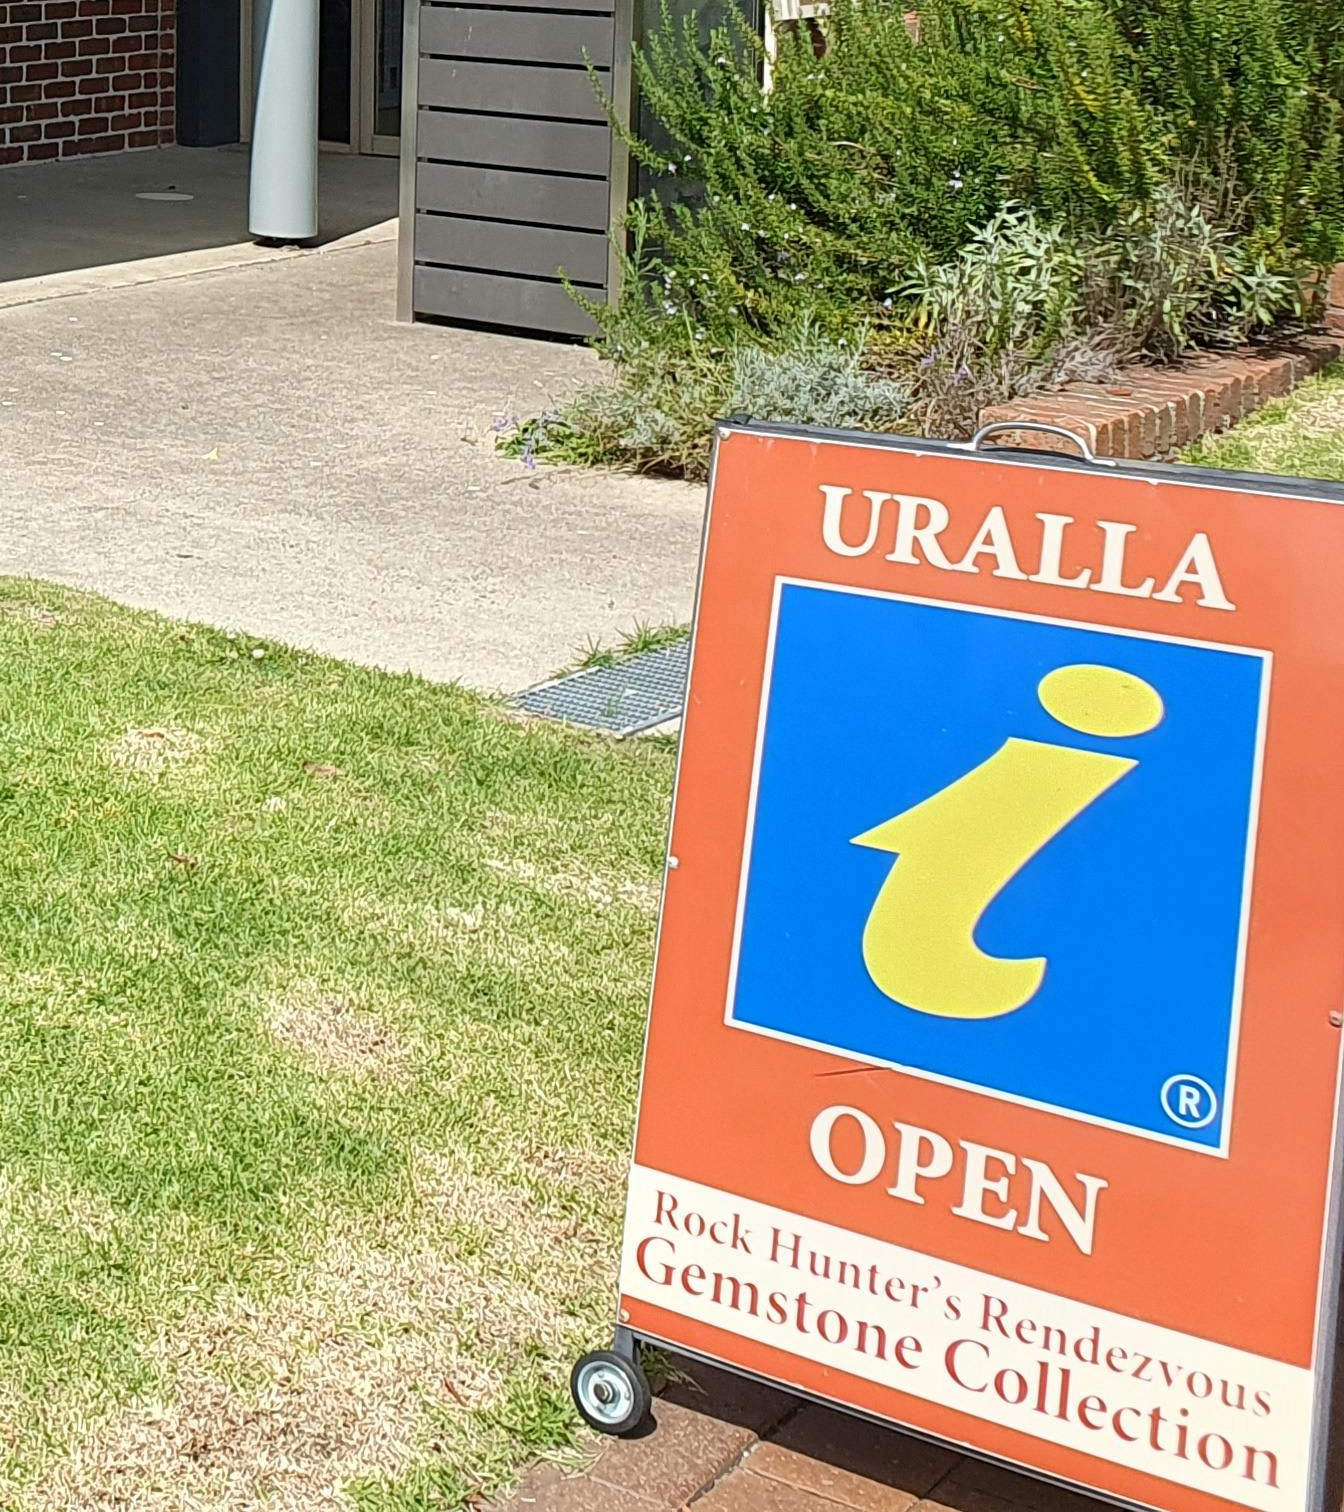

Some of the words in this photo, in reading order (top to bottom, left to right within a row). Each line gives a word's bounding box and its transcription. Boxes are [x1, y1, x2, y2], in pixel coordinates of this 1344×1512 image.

[818, 483, 1238, 613] URALLA
[808, 1103, 1110, 1257] OPEN
[635, 1234, 924, 1370] Gemstone
[944, 1338, 1282, 1490] Collection
[654, 1189, 753, 1256] Rock
[769, 1225, 962, 1323] Hunter's
[979, 1291, 1273, 1419] Rendezvous
